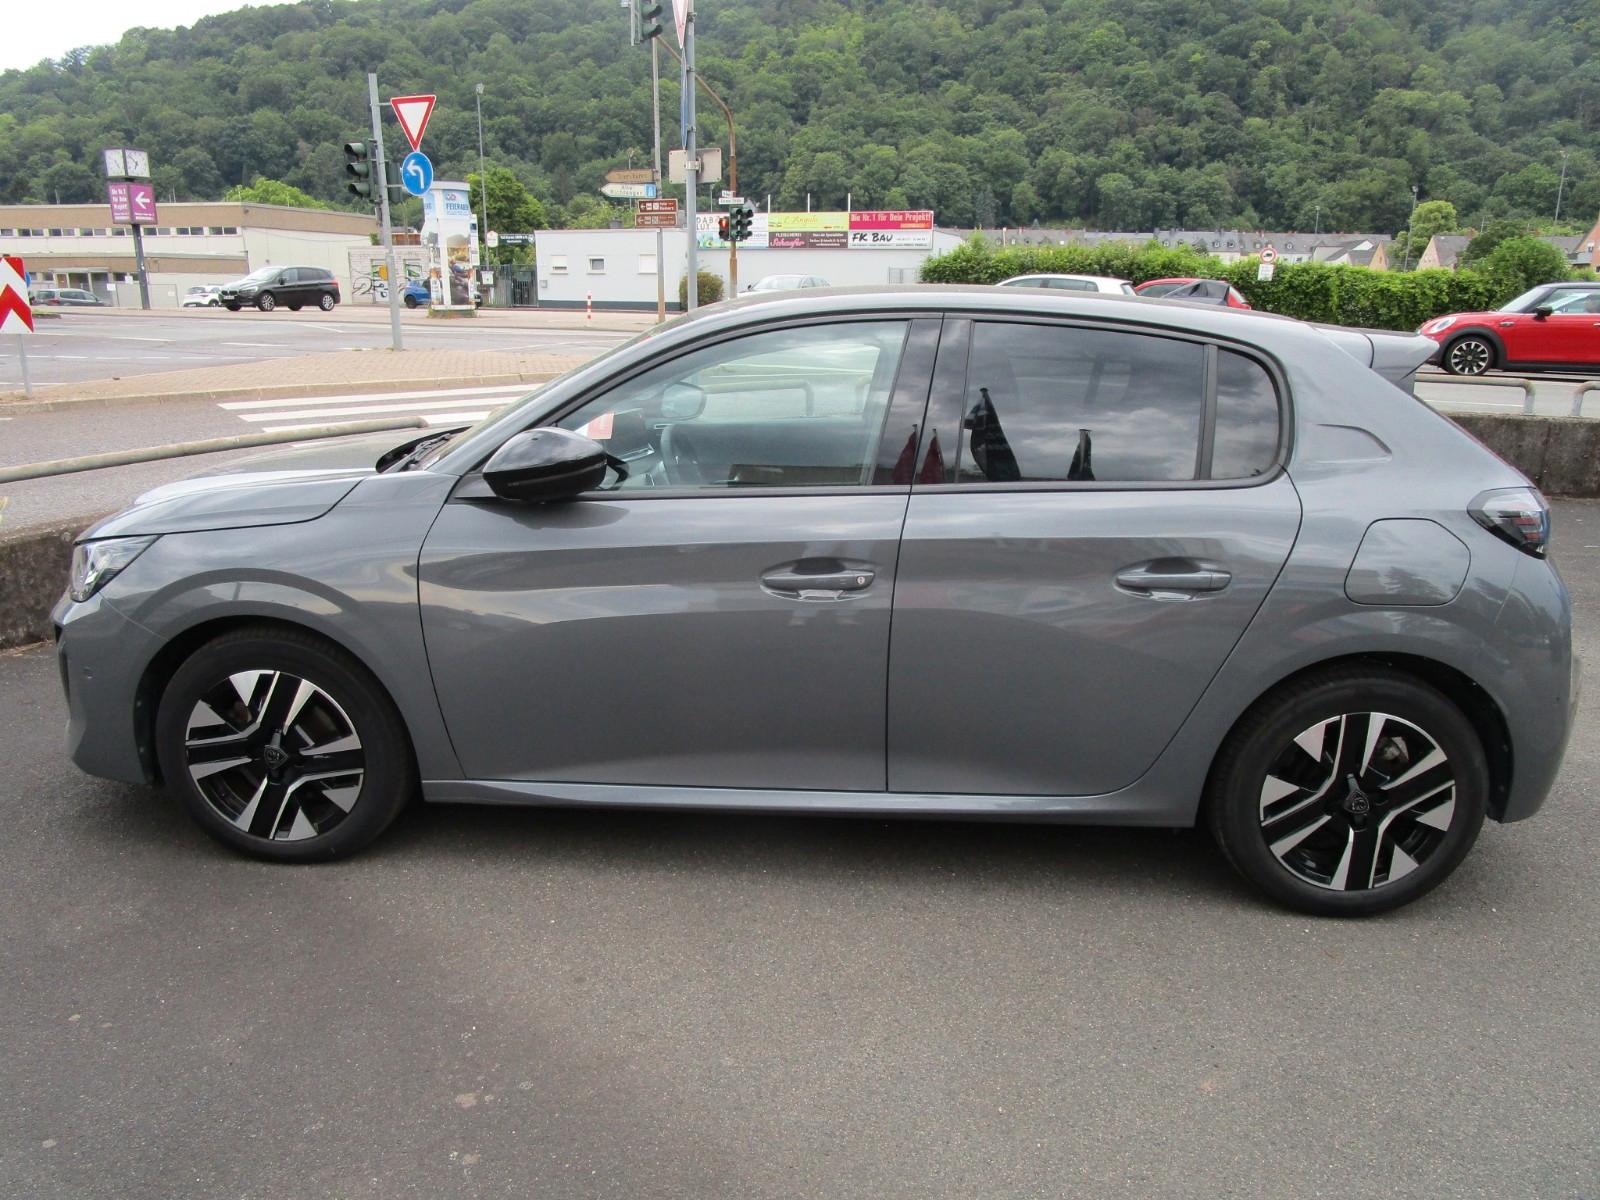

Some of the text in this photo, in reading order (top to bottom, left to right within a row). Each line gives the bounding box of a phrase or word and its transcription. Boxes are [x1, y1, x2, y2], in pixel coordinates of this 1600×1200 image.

[850, 213, 860, 221] Die
[862, 213, 872, 221] Nr.
[877, 212, 887, 221] für
[889, 212, 903, 221] Dein
[905, 212, 931, 223] Projekt!
[852, 232, 868, 242] FK
[871, 232, 893, 242] BAU
